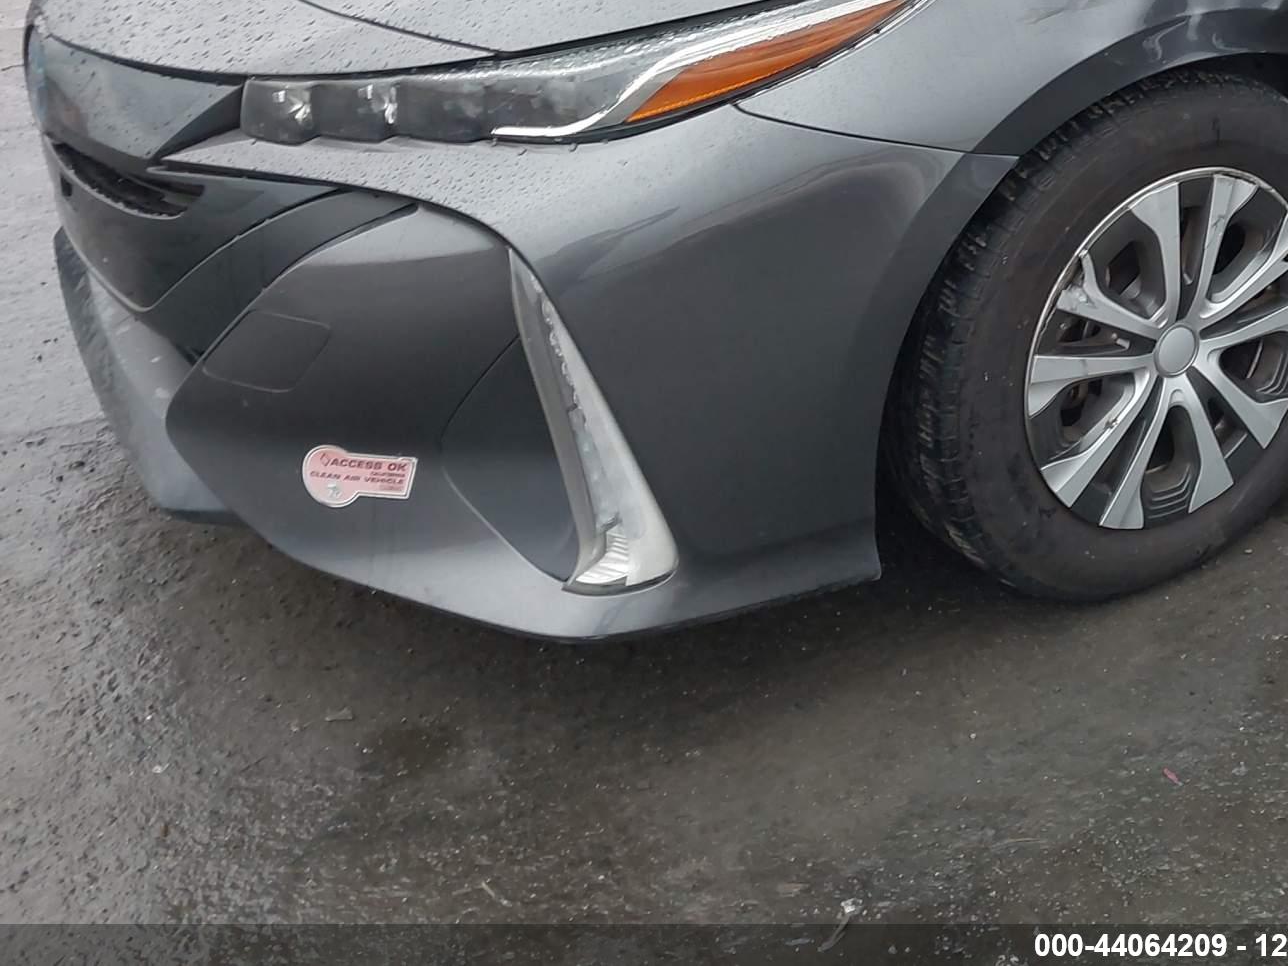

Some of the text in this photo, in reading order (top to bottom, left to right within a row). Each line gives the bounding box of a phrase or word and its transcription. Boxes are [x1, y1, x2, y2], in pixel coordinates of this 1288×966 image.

[330, 457, 408, 472] ACCESS OK
[310, 470, 404, 485] CLEAN AIR VEHICLE
